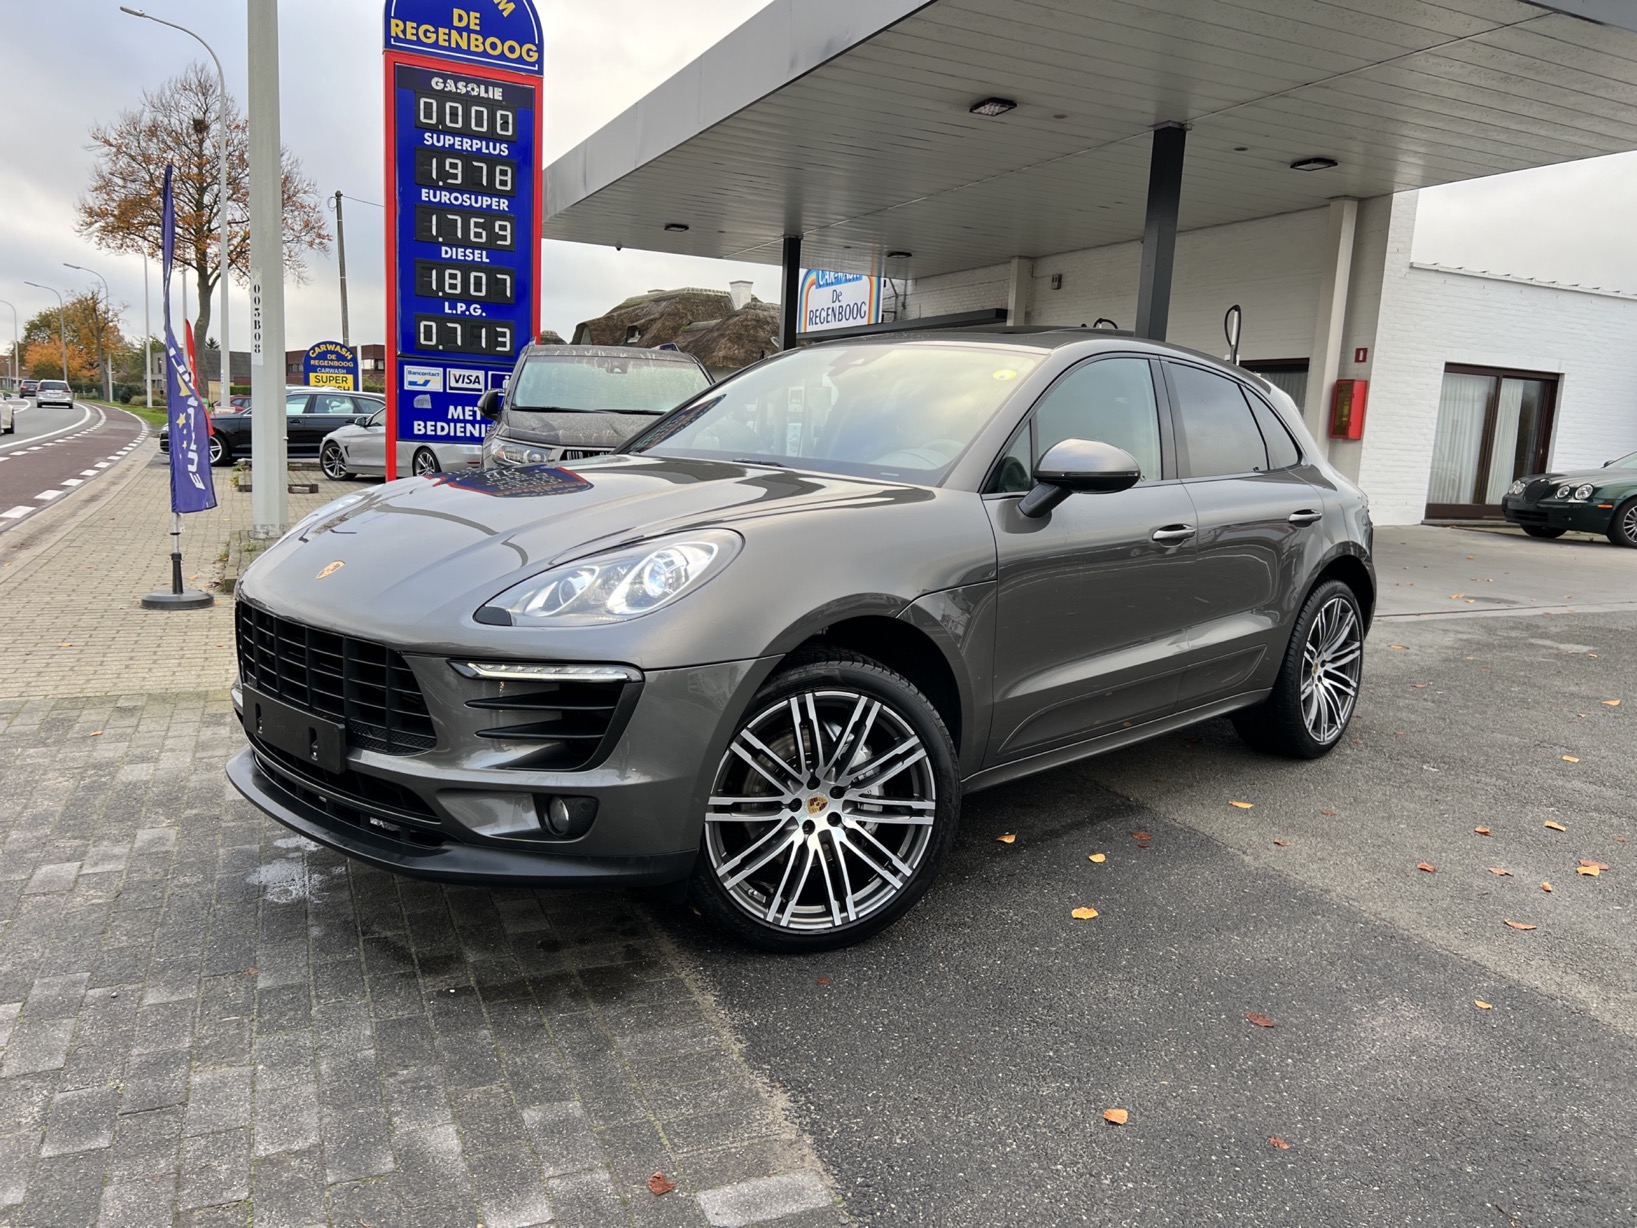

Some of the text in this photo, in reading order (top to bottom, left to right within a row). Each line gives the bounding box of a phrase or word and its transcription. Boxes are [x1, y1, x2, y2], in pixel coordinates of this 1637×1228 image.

[453, 8, 480, 31] DE
[390, 18, 539, 62] REGENBOOG
[423, 132, 509, 156] SUPERPLUS
[431, 157, 512, 191] 1.978
[421, 188, 509, 211] EUROSUPER
[431, 214, 511, 245] 1.769
[441, 246, 490, 262] DIESEL
[431, 269, 511, 298] 1.807
[832, 289, 843, 304] De
[444, 302, 487, 317] L.P.G.
[808, 301, 867, 326] REGENBOOG
[419, 320, 511, 352] 0.713
[309, 343, 353, 360] CARWASH
[314, 375, 348, 384] SUPER
[452, 373, 481, 385] VISA
[413, 420, 491, 438] BEDIENI
